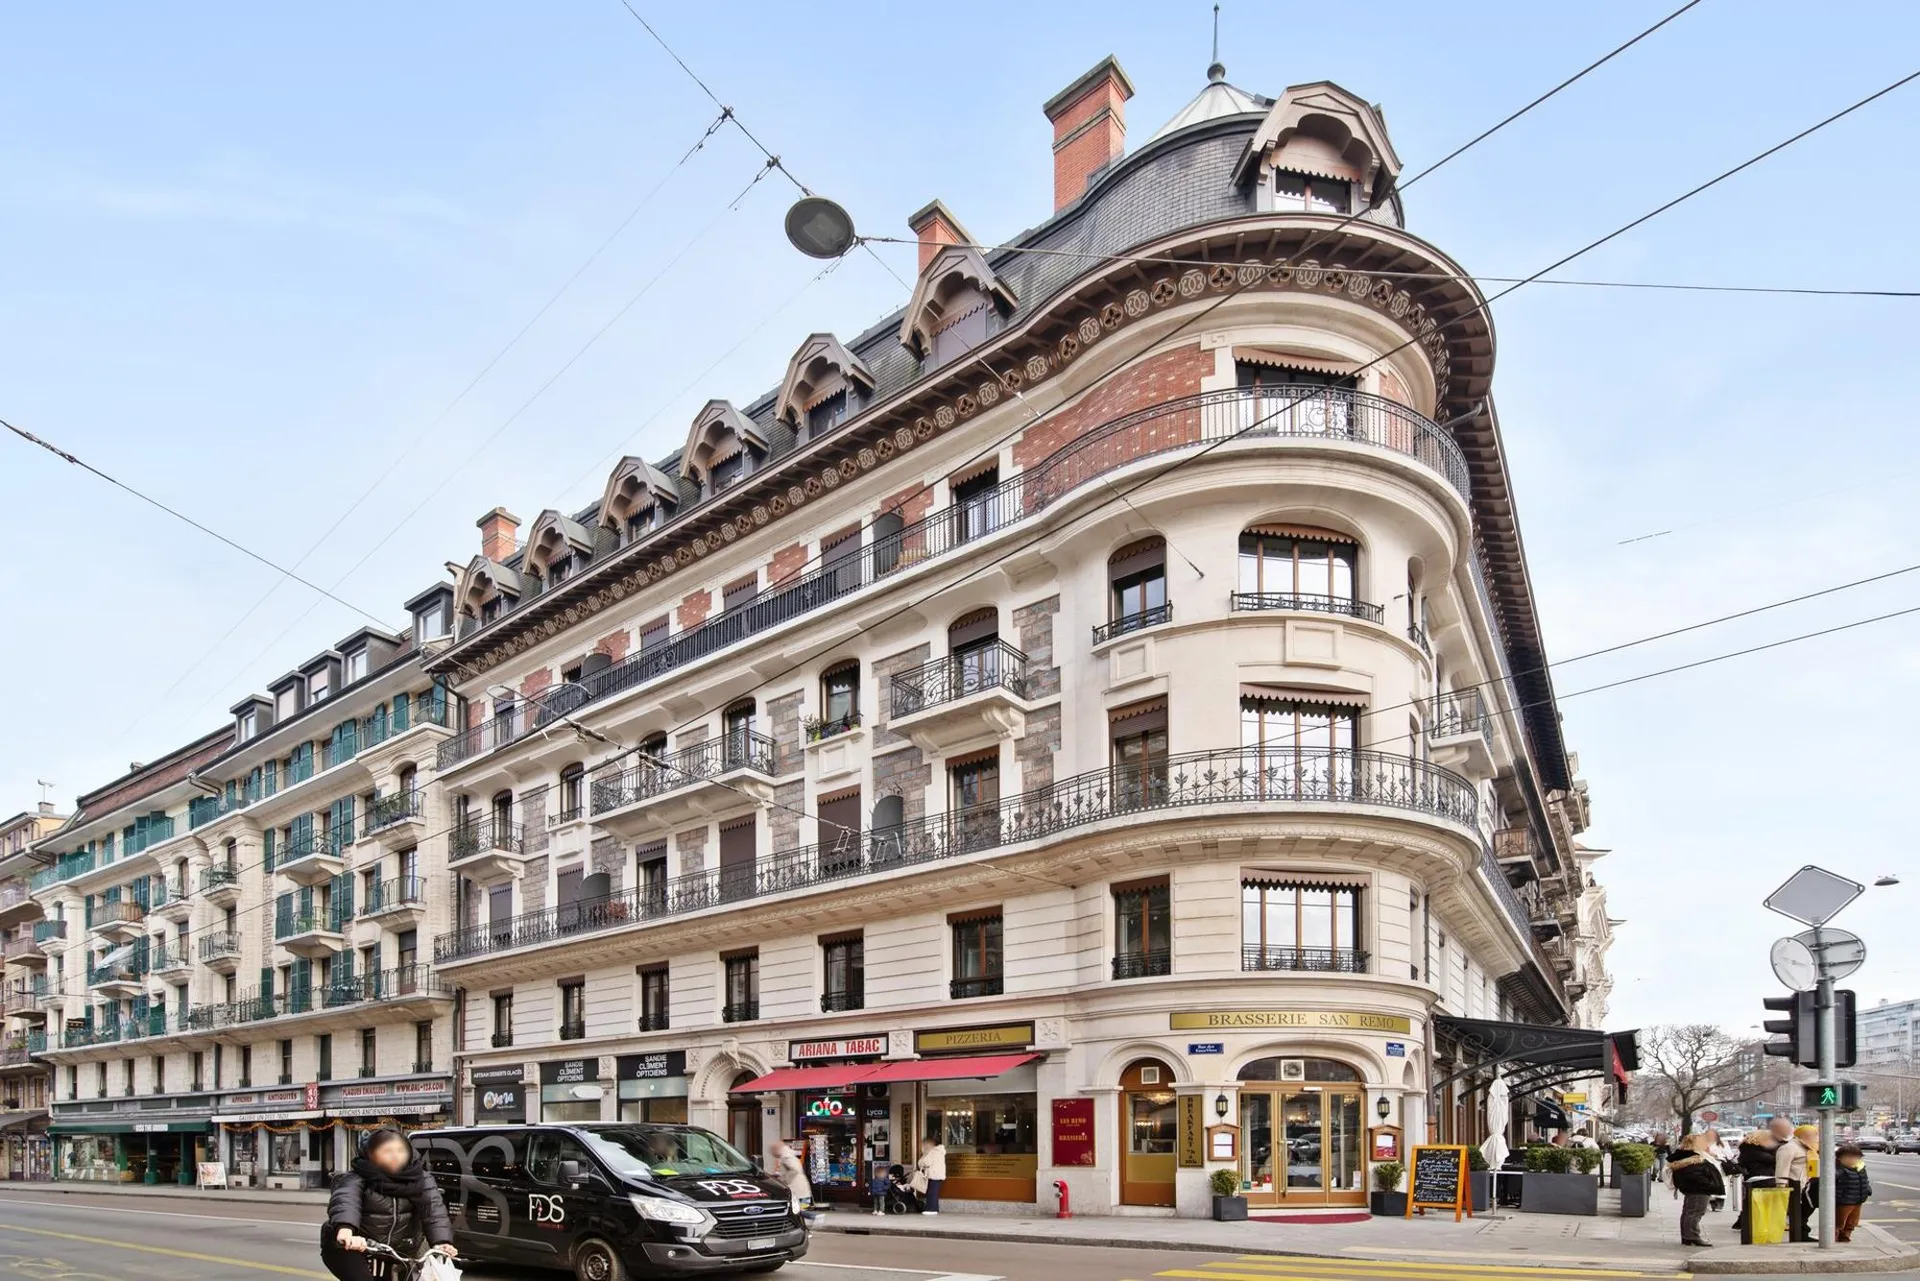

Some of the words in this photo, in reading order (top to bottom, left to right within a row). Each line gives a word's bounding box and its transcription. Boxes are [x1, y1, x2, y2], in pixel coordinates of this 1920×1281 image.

[1208, 1013, 1307, 1026] BRASSERIE
[1319, 1014, 1349, 1026] SAN
[1360, 1016, 1394, 1028] REMO
[945, 1031, 1001, 1045] PIZZERIA
[798, 1042, 837, 1057] ARIANA
[845, 1039, 880, 1054] TABAC
[696, 1179, 761, 1196] FDS
[528, 1193, 565, 1223] FDS
